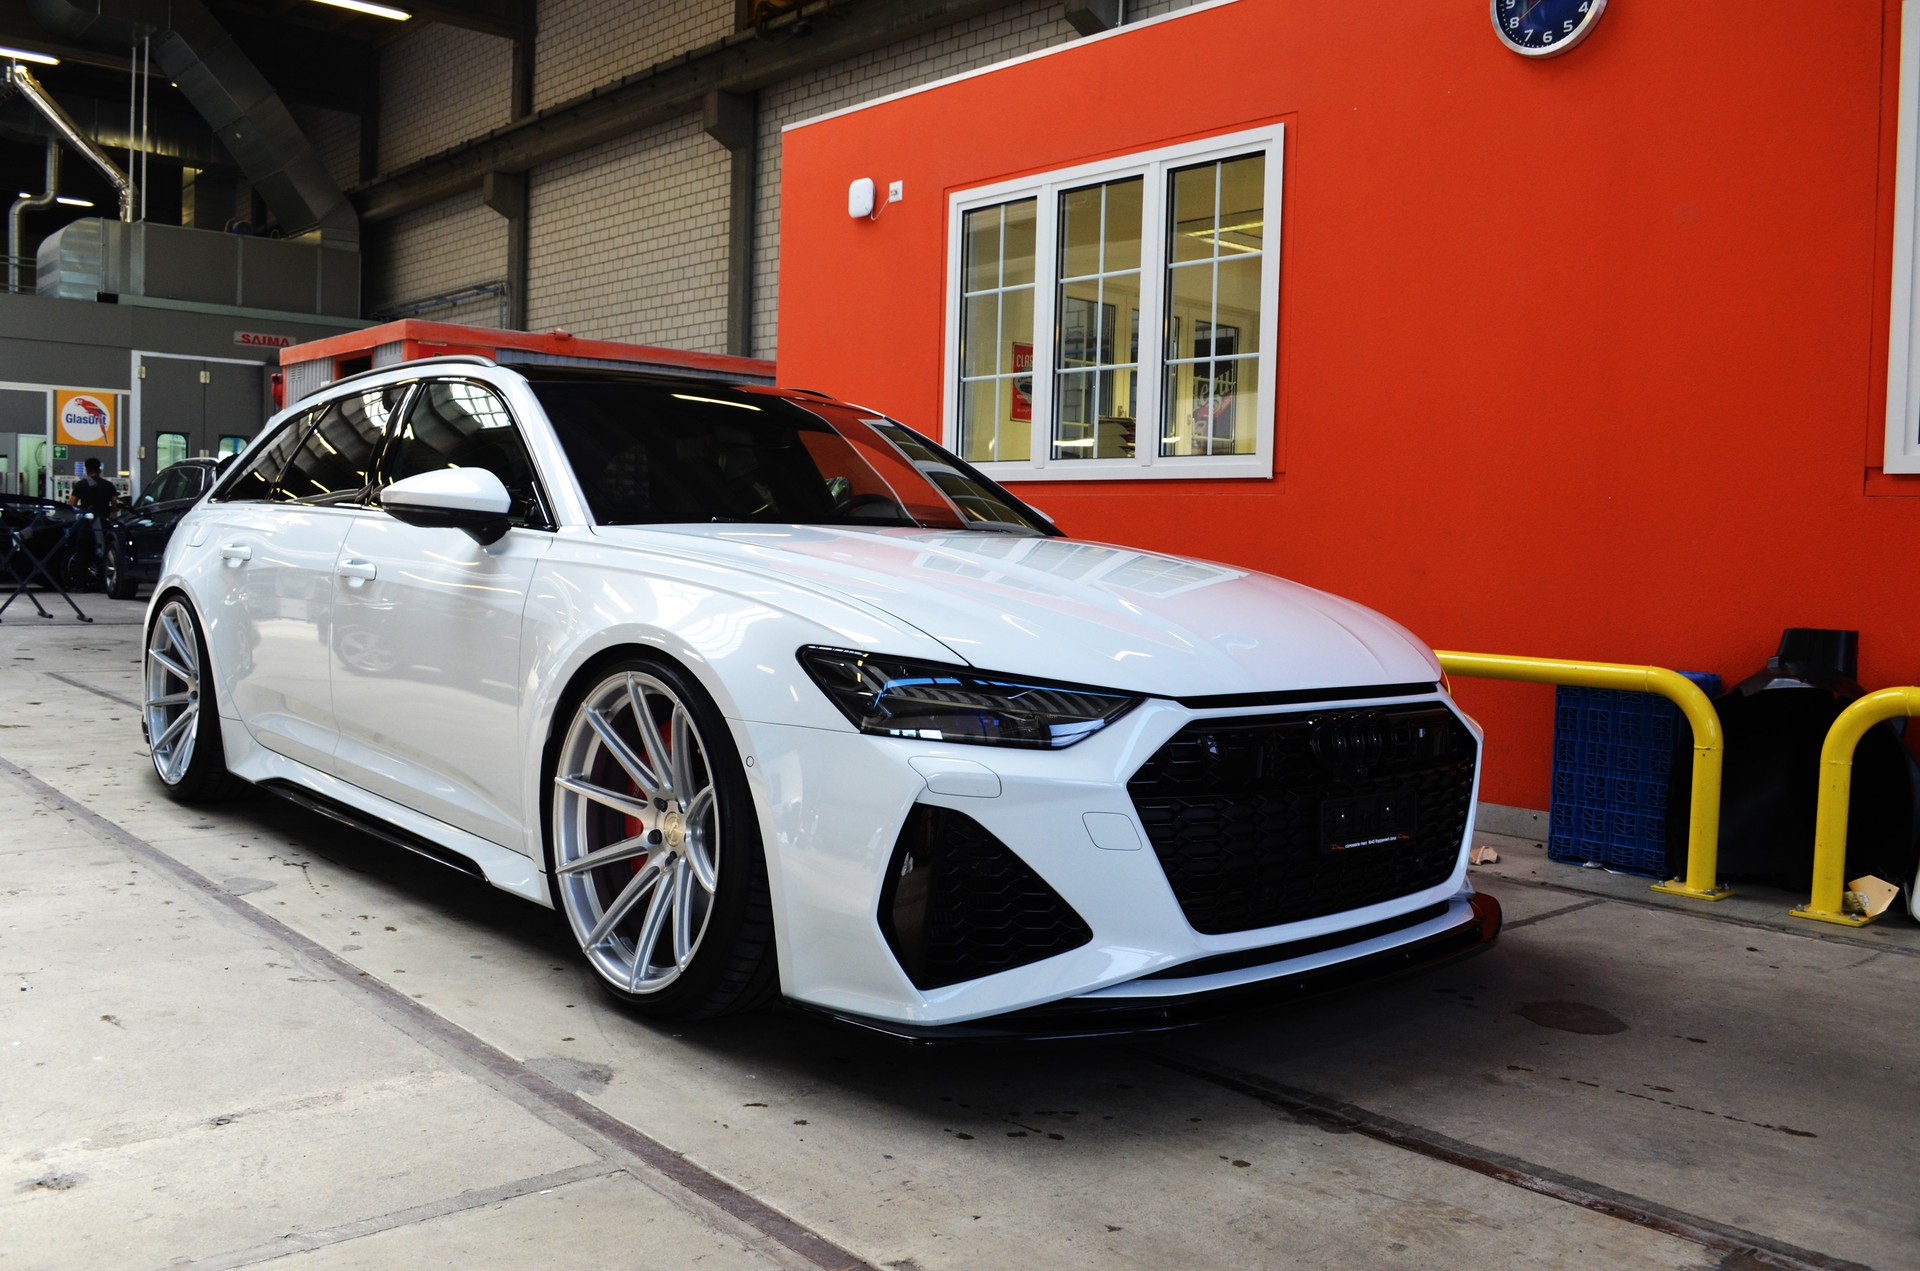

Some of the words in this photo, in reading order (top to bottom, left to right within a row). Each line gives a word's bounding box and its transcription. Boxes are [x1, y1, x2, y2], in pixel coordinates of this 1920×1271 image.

[1506, 0, 1515, 9] 9
[1578, 1, 1588, 13] 4
[1509, 17, 1519, 28] 8
[1563, 20, 1573, 33] 5
[1524, 29, 1534, 42] 7
[1542, 31, 1552, 43] 6
[241, 333, 290, 347] SAIMA
[65, 413, 106, 425] Glasurit
